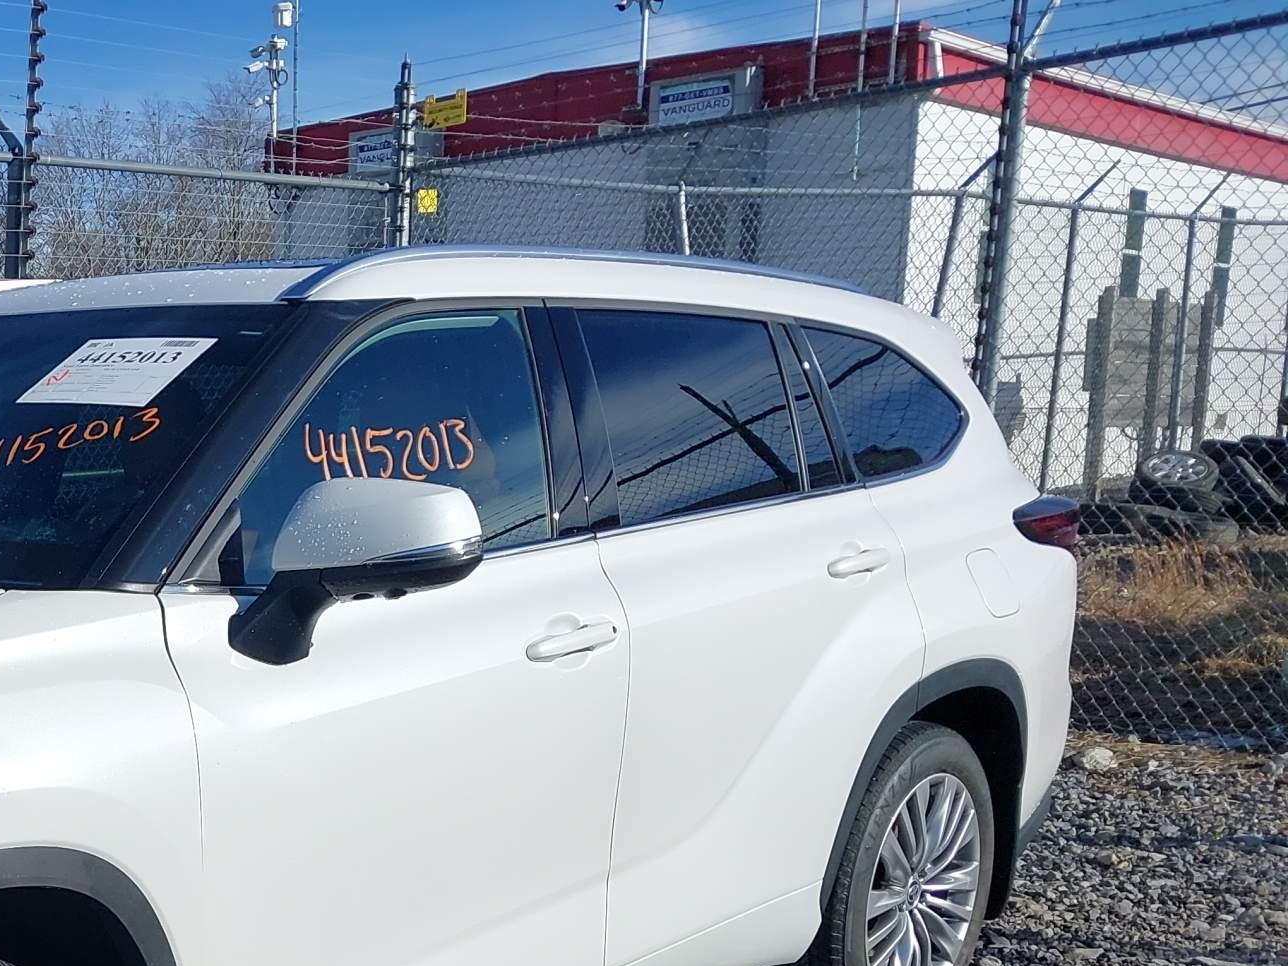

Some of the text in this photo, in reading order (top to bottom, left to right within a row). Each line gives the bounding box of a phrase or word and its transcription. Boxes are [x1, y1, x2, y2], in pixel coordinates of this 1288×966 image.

[661, 97, 730, 117] VANGUARD
[76, 351, 183, 365] 44152013
[304, 417, 475, 481] 44152013
